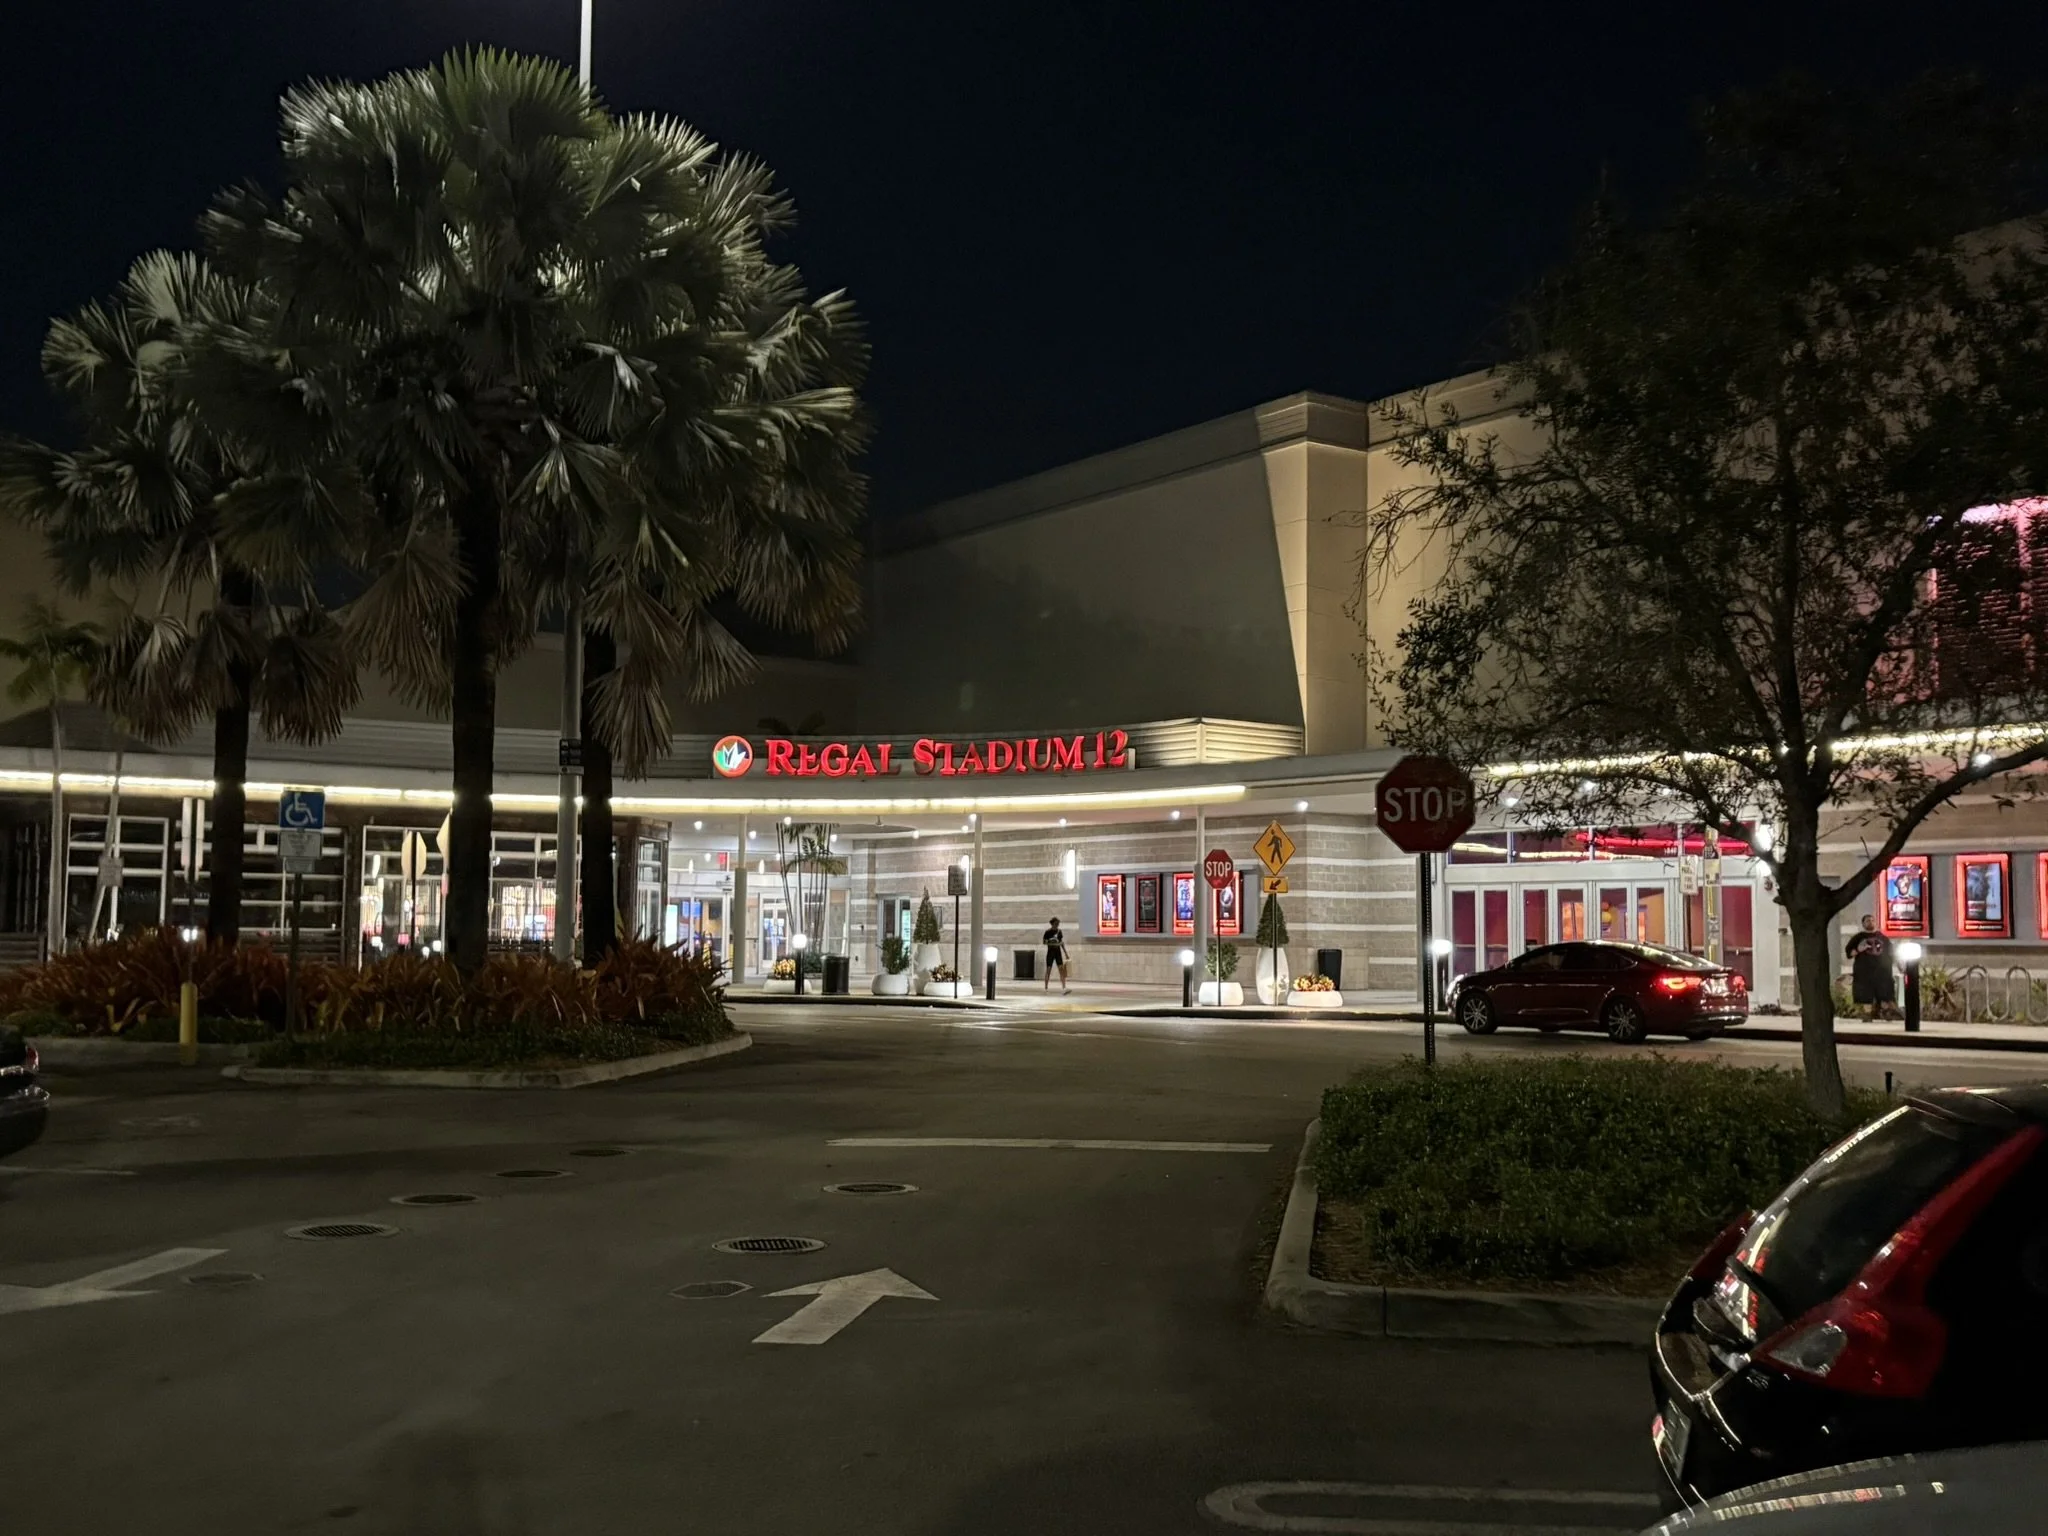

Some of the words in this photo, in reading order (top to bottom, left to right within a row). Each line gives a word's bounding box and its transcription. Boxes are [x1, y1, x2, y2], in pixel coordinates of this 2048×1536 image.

[766, 739, 901, 776] REGAL
[912, 735, 1086, 774] STADIUM
[1094, 729, 1128, 769] 12
[1383, 786, 1467, 823] STOP
[1206, 861, 1232, 877] STOP
